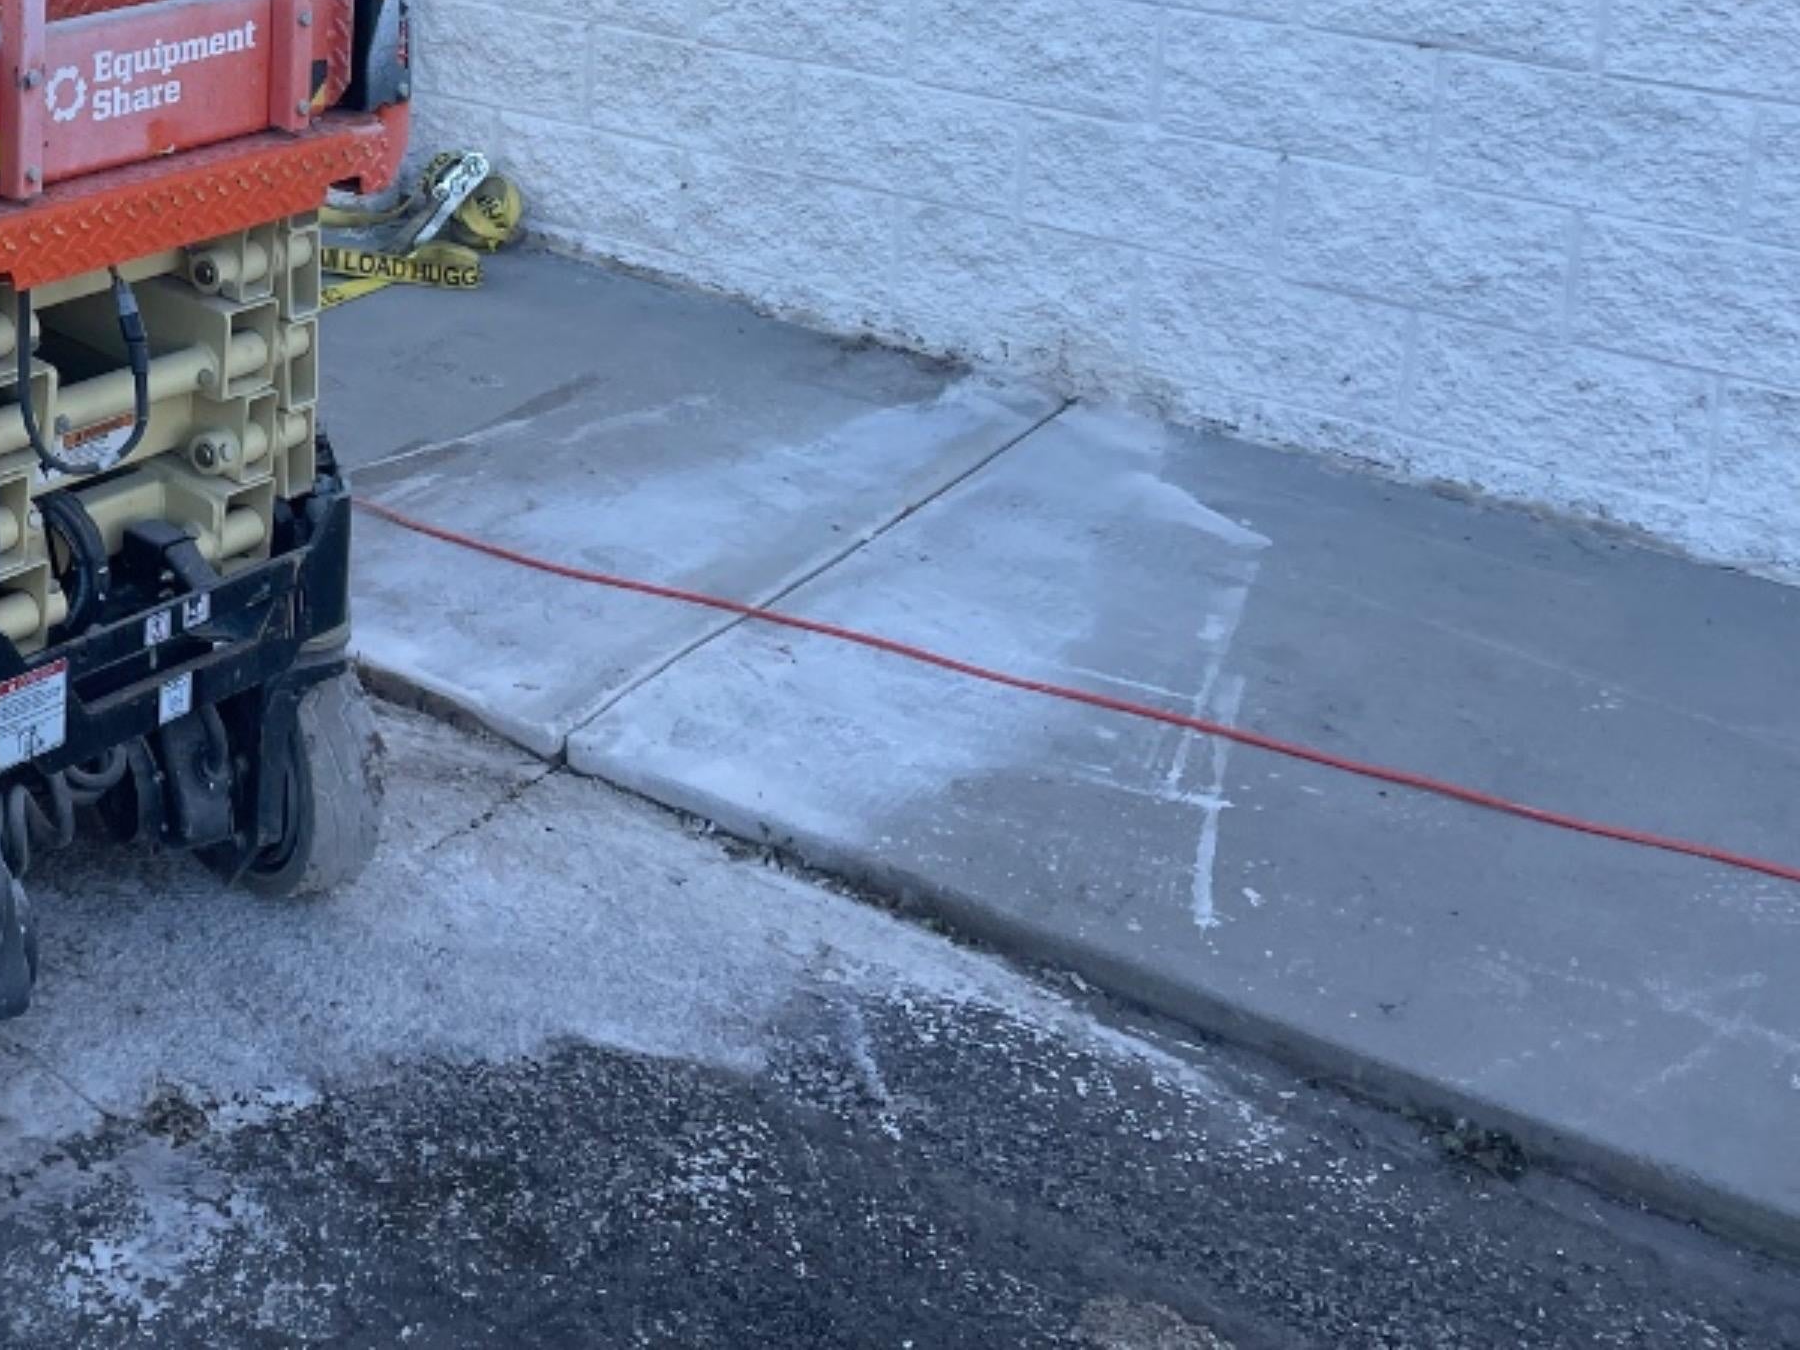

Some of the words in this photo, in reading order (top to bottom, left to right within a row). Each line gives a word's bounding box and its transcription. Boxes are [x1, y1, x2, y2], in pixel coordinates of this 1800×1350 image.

[93, 20, 256, 84] Equipment
[92, 80, 181, 121] Share
[343, 252, 405, 277] LOAD
